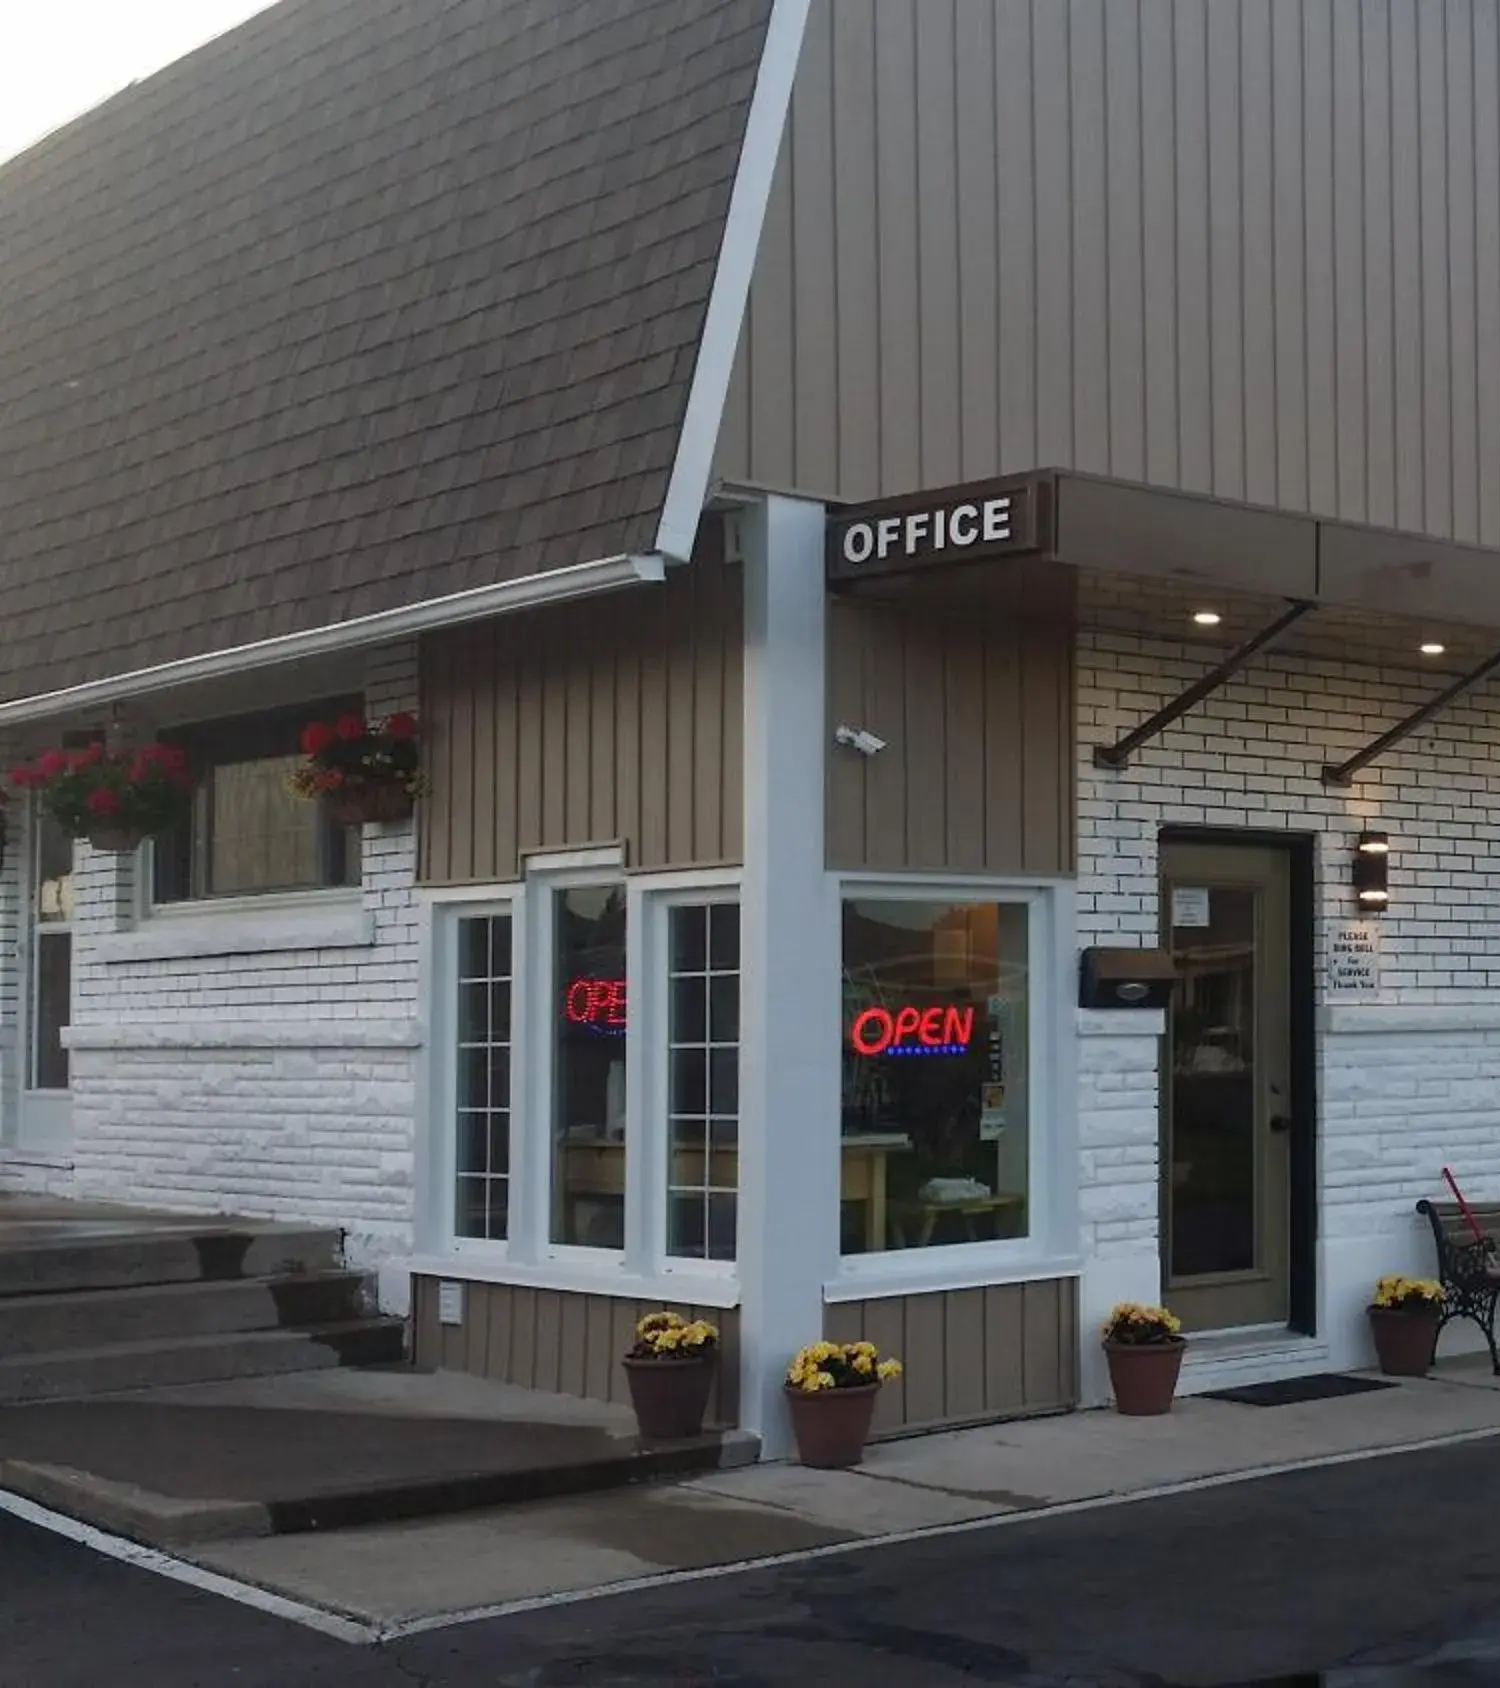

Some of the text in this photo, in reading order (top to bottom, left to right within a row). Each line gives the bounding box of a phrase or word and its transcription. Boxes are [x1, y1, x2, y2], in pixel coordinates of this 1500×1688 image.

[843, 498, 1010, 563] OFFICE
[1338, 931, 1368, 941] PLEASE
[567, 979, 626, 1024] OPE
[853, 1006, 975, 1056] OPEN
